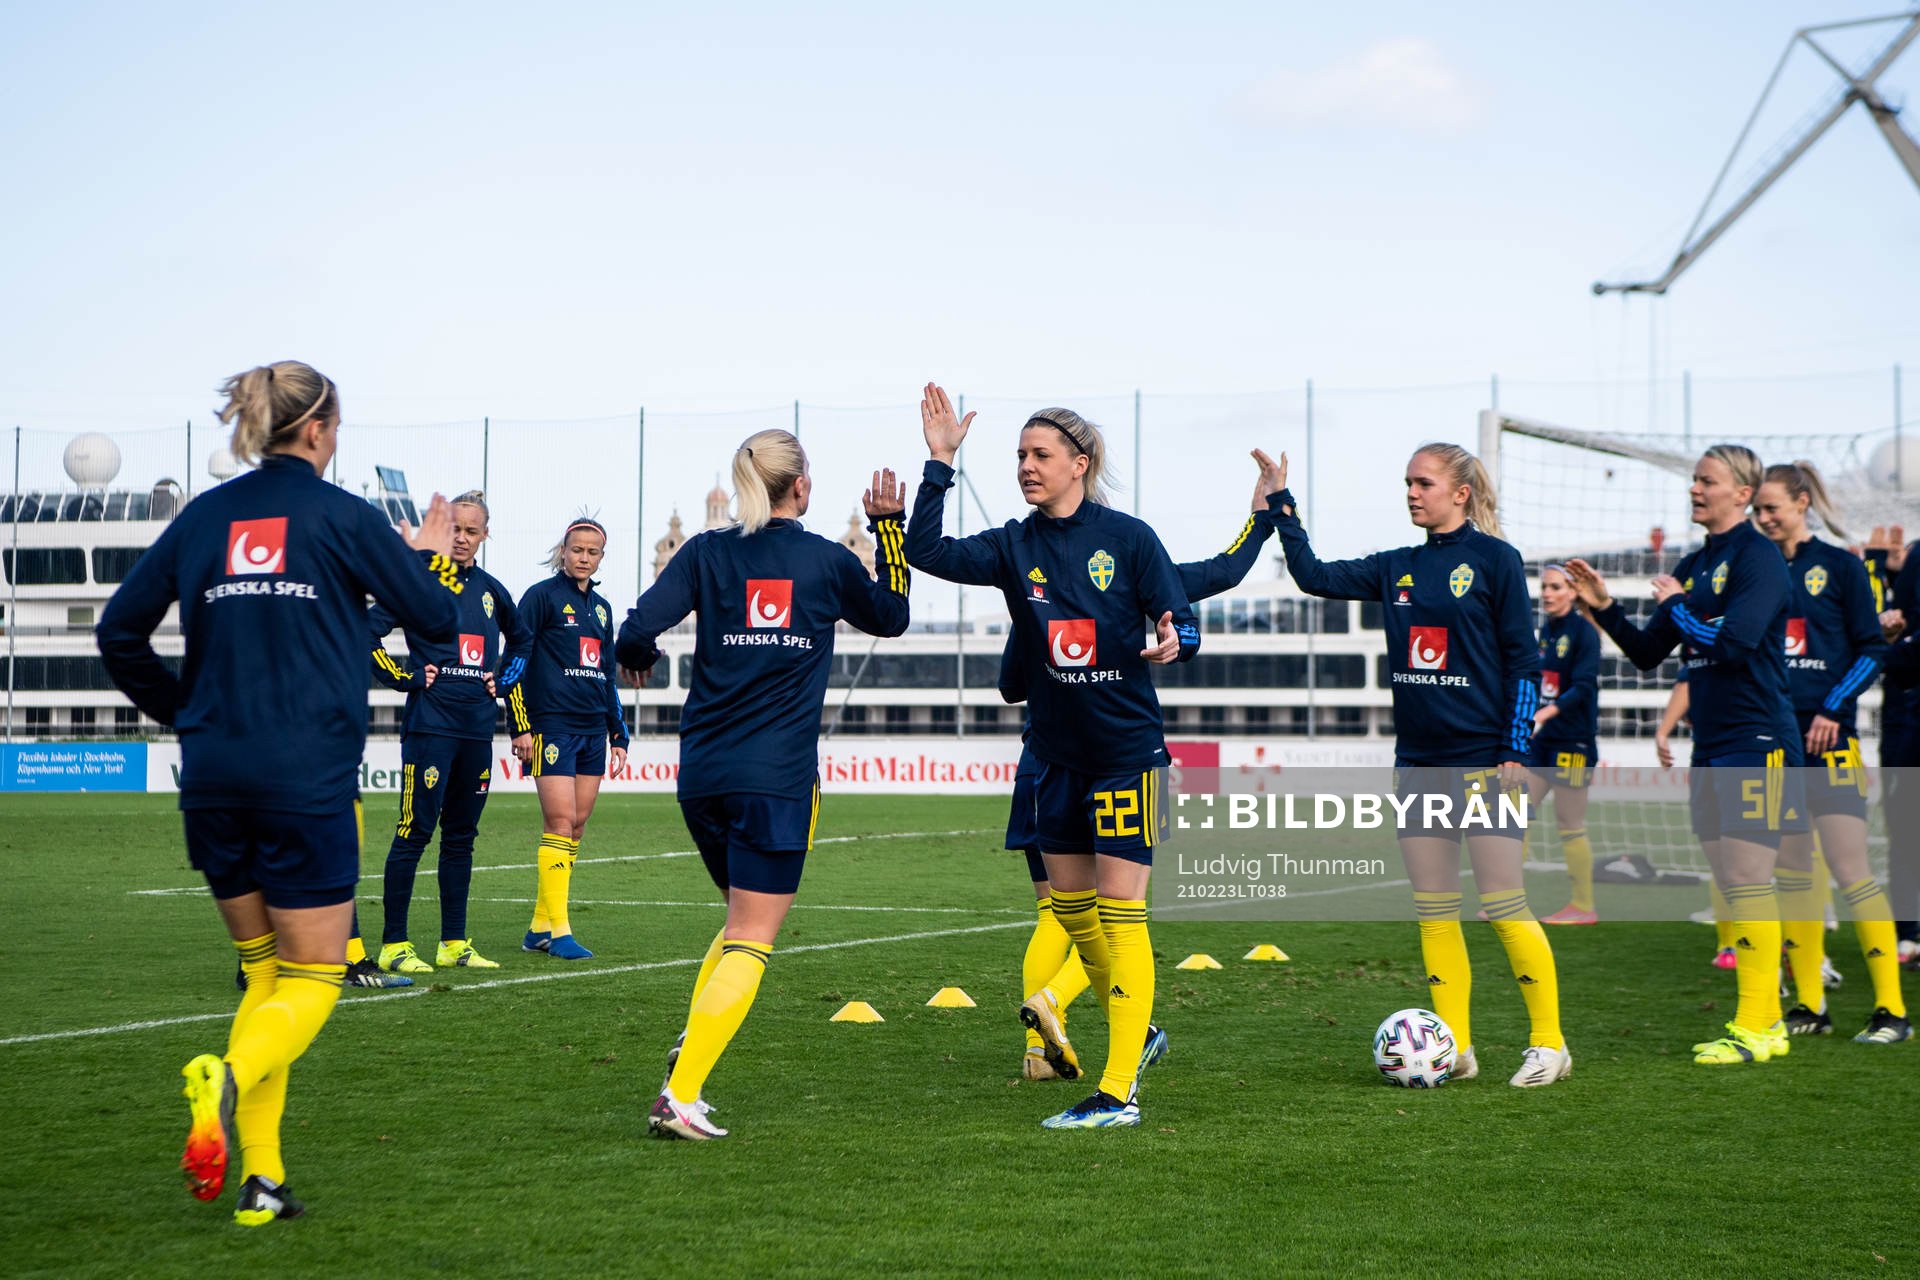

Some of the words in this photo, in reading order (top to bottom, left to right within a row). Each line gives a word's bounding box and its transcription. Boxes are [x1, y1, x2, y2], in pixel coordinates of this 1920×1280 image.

[274, 581, 318, 599] SPEL
[722, 634, 779, 645] SVENSKA
[782, 635, 813, 649] SPEL
[1802, 658, 1827, 670] SPEL
[441, 667, 480, 677] SVENSKA
[564, 668, 597, 678] SVENSKA
[1091, 670, 1123, 683] SPEL
[1393, 673, 1437, 685] SVENSKA
[1439, 676, 1471, 687] SPEL
[1821, 750, 1856, 786] 13
[1742, 780, 1765, 819] 5
[1094, 790, 1140, 837] 22
